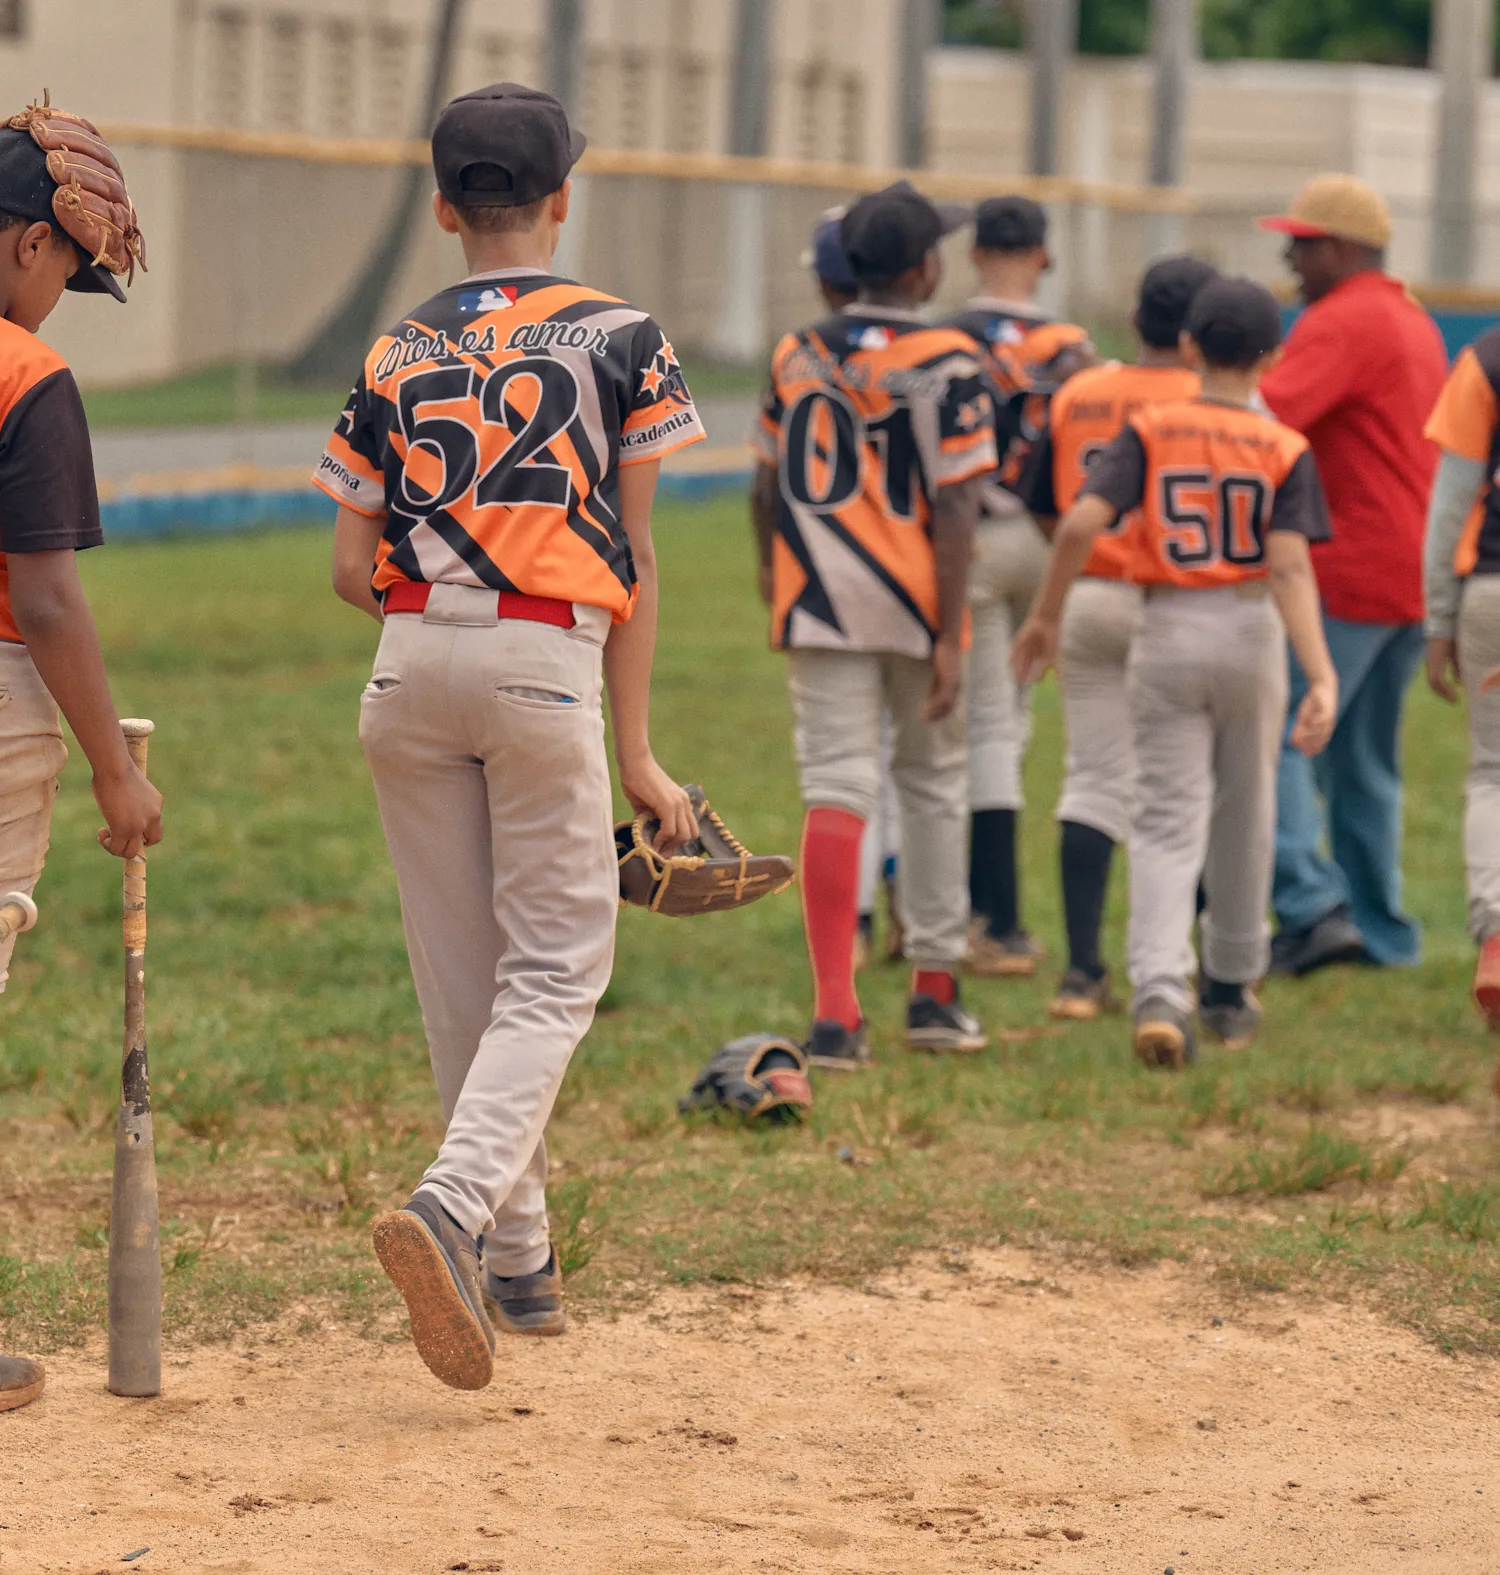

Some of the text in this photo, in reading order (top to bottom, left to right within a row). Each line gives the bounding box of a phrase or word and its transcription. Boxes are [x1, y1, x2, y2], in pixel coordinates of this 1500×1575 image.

[374, 320, 610, 384] Dios es amor
[390, 355, 581, 521] 52
[777, 387, 922, 524] 01
[1156, 465, 1274, 571] 50
